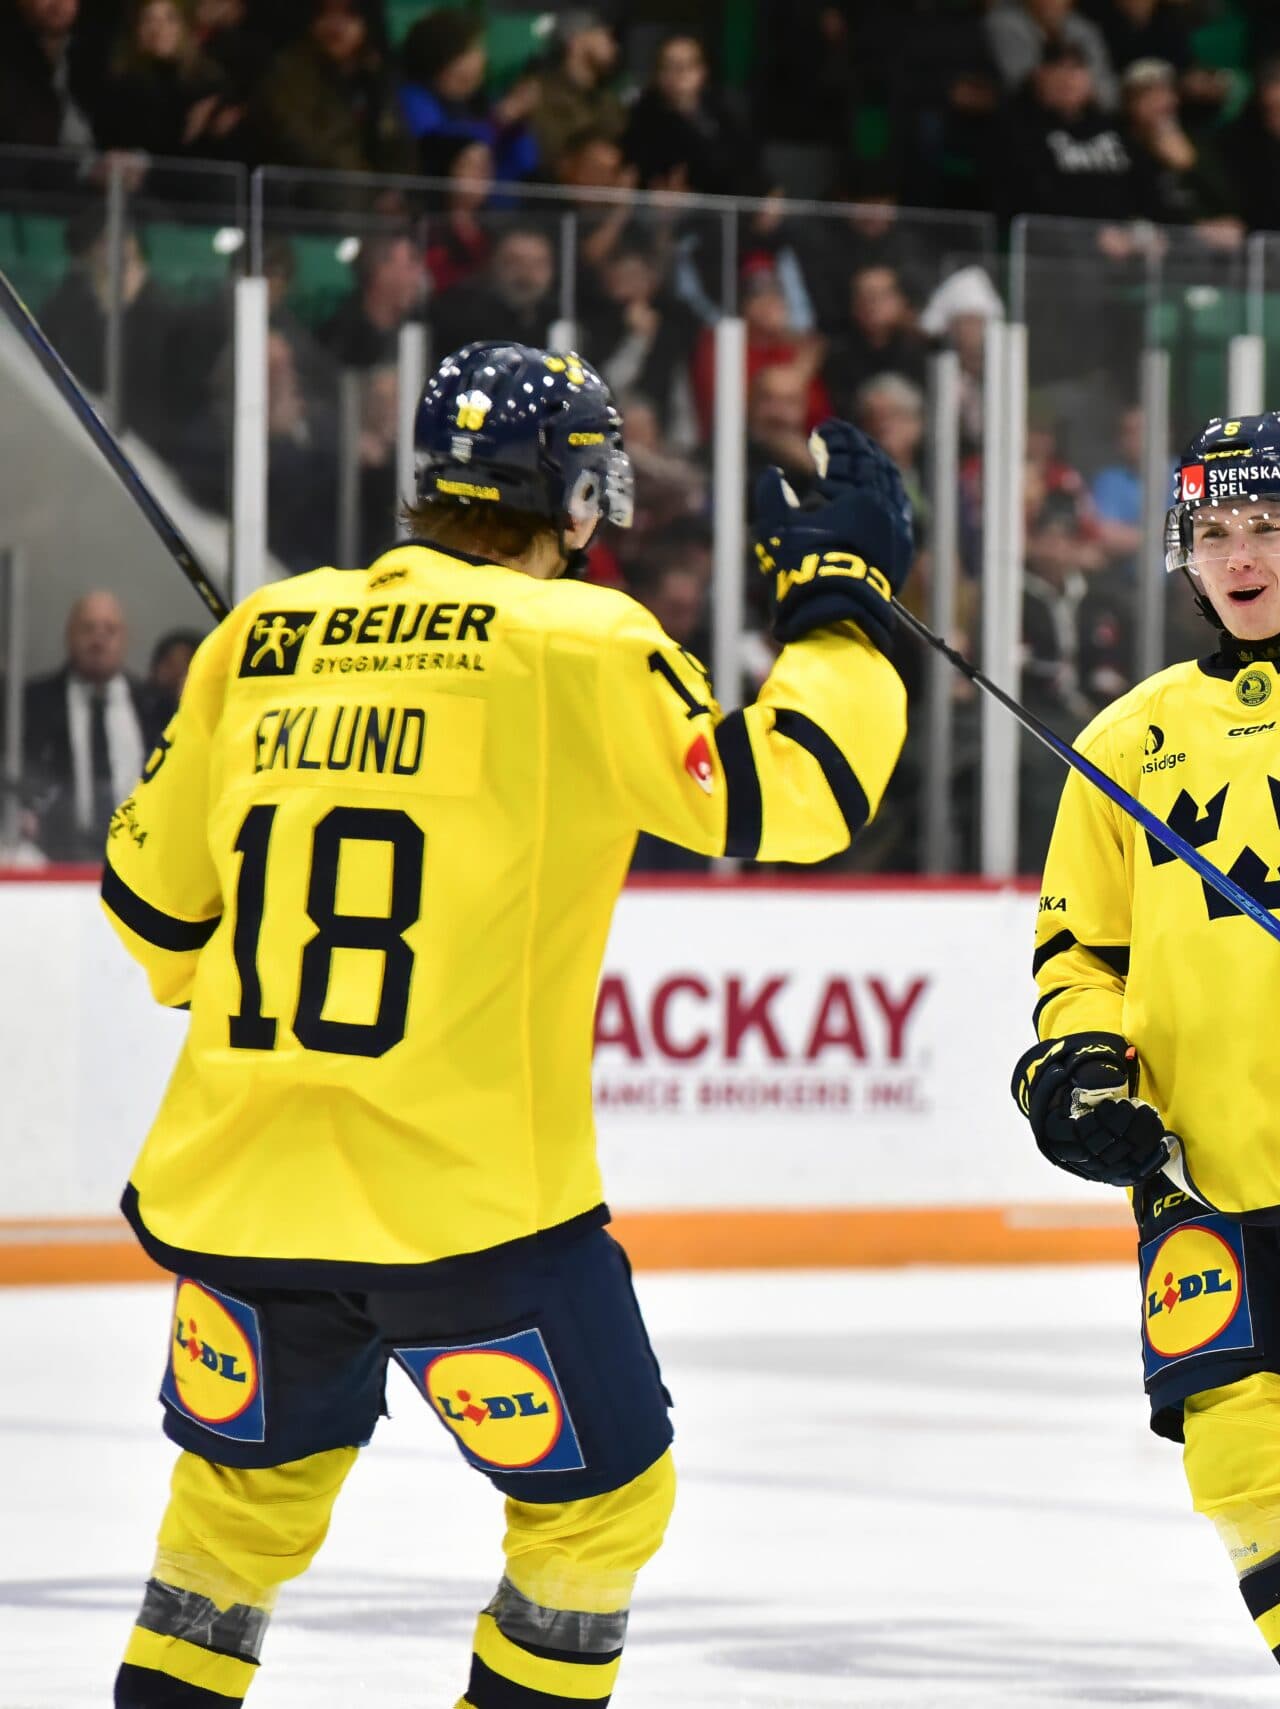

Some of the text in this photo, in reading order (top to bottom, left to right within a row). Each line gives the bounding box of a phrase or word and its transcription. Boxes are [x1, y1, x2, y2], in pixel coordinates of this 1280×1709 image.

[1223, 421, 1242, 437] 5
[1209, 482, 1249, 498] SPEL
[322, 602, 497, 646] BEIJER
[311, 652, 487, 675] BYGGMATERIAL
[253, 705, 427, 776] EKLUND
[1227, 720, 1278, 739] CCM
[227, 803, 426, 1059] 18
[699, 1080, 850, 1107] BROKERS
